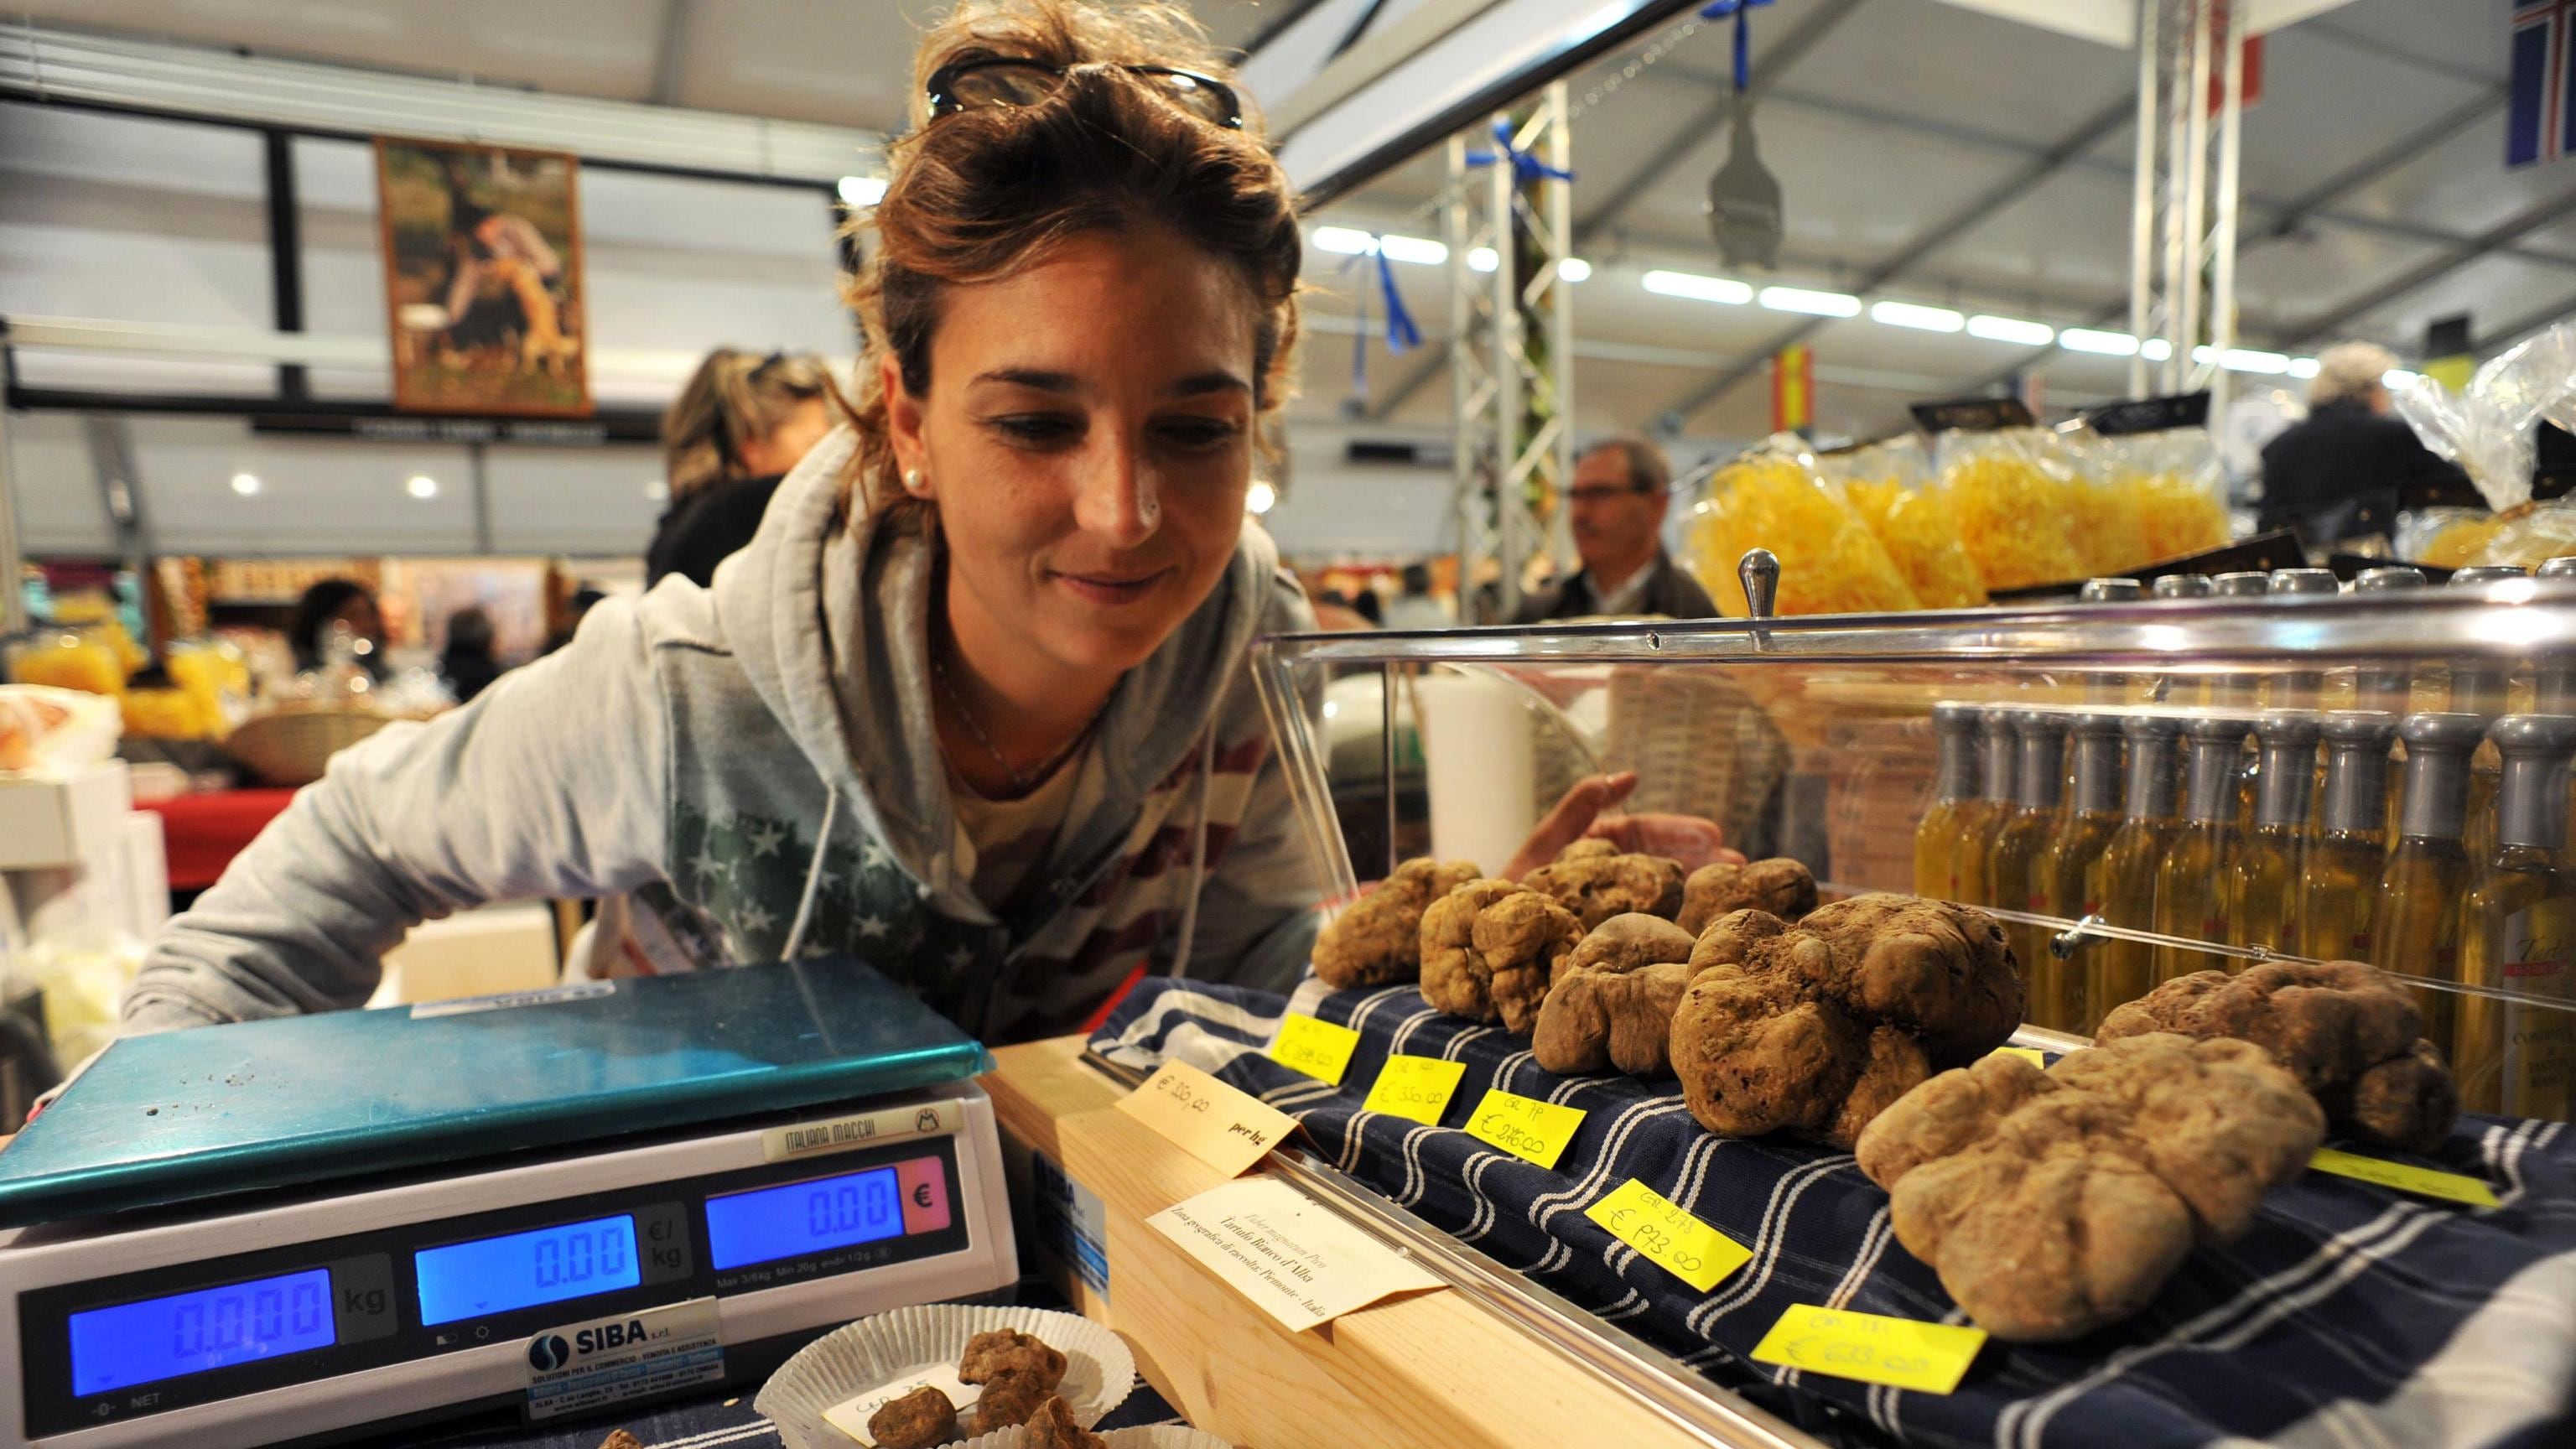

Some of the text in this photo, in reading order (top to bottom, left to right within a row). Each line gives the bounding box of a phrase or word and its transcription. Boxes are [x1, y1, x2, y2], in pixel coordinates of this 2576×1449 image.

[1156, 1075, 1176, 1091] €
[1379, 1081, 1396, 1104] €
[785, 1118, 876, 1151] ITALIANA MACCHI
[1227, 1123, 1269, 1147] per hg
[1481, 1114, 1505, 1135] €
[808, 1180, 933, 1239] 0.00 €
[1610, 1208, 1638, 1231] €
[534, 1225, 626, 1289] 0.00
[1220, 1215, 1316, 1284] Tartufo Bianco d'Alba
[1244, 1213, 1329, 1270] Tuber magnatum Pico
[652, 1246, 683, 1270] kg
[1171, 1206, 1192, 1223] Zona
[1184, 1220, 1223, 1246] geografica
[1220, 1241, 1234, 1253] di
[1258, 1269, 1300, 1299] Piemonte
[1301, 1298, 1327, 1318] Italia
[717, 1277, 737, 1290] Max
[776, 1266, 795, 1277] Min
[173, 1280, 386, 1360] 0.000 kg
[575, 1319, 648, 1355] SIBA
[1783, 1334, 1820, 1363] €
[532, 1369, 571, 1384] SOLUZIONI
[571, 1367, 586, 1377] PER
[595, 1355, 637, 1371] COMMERCIO
[678, 1338, 716, 1352] ASSISTENZA
[130, 1392, 161, 1409] NET
